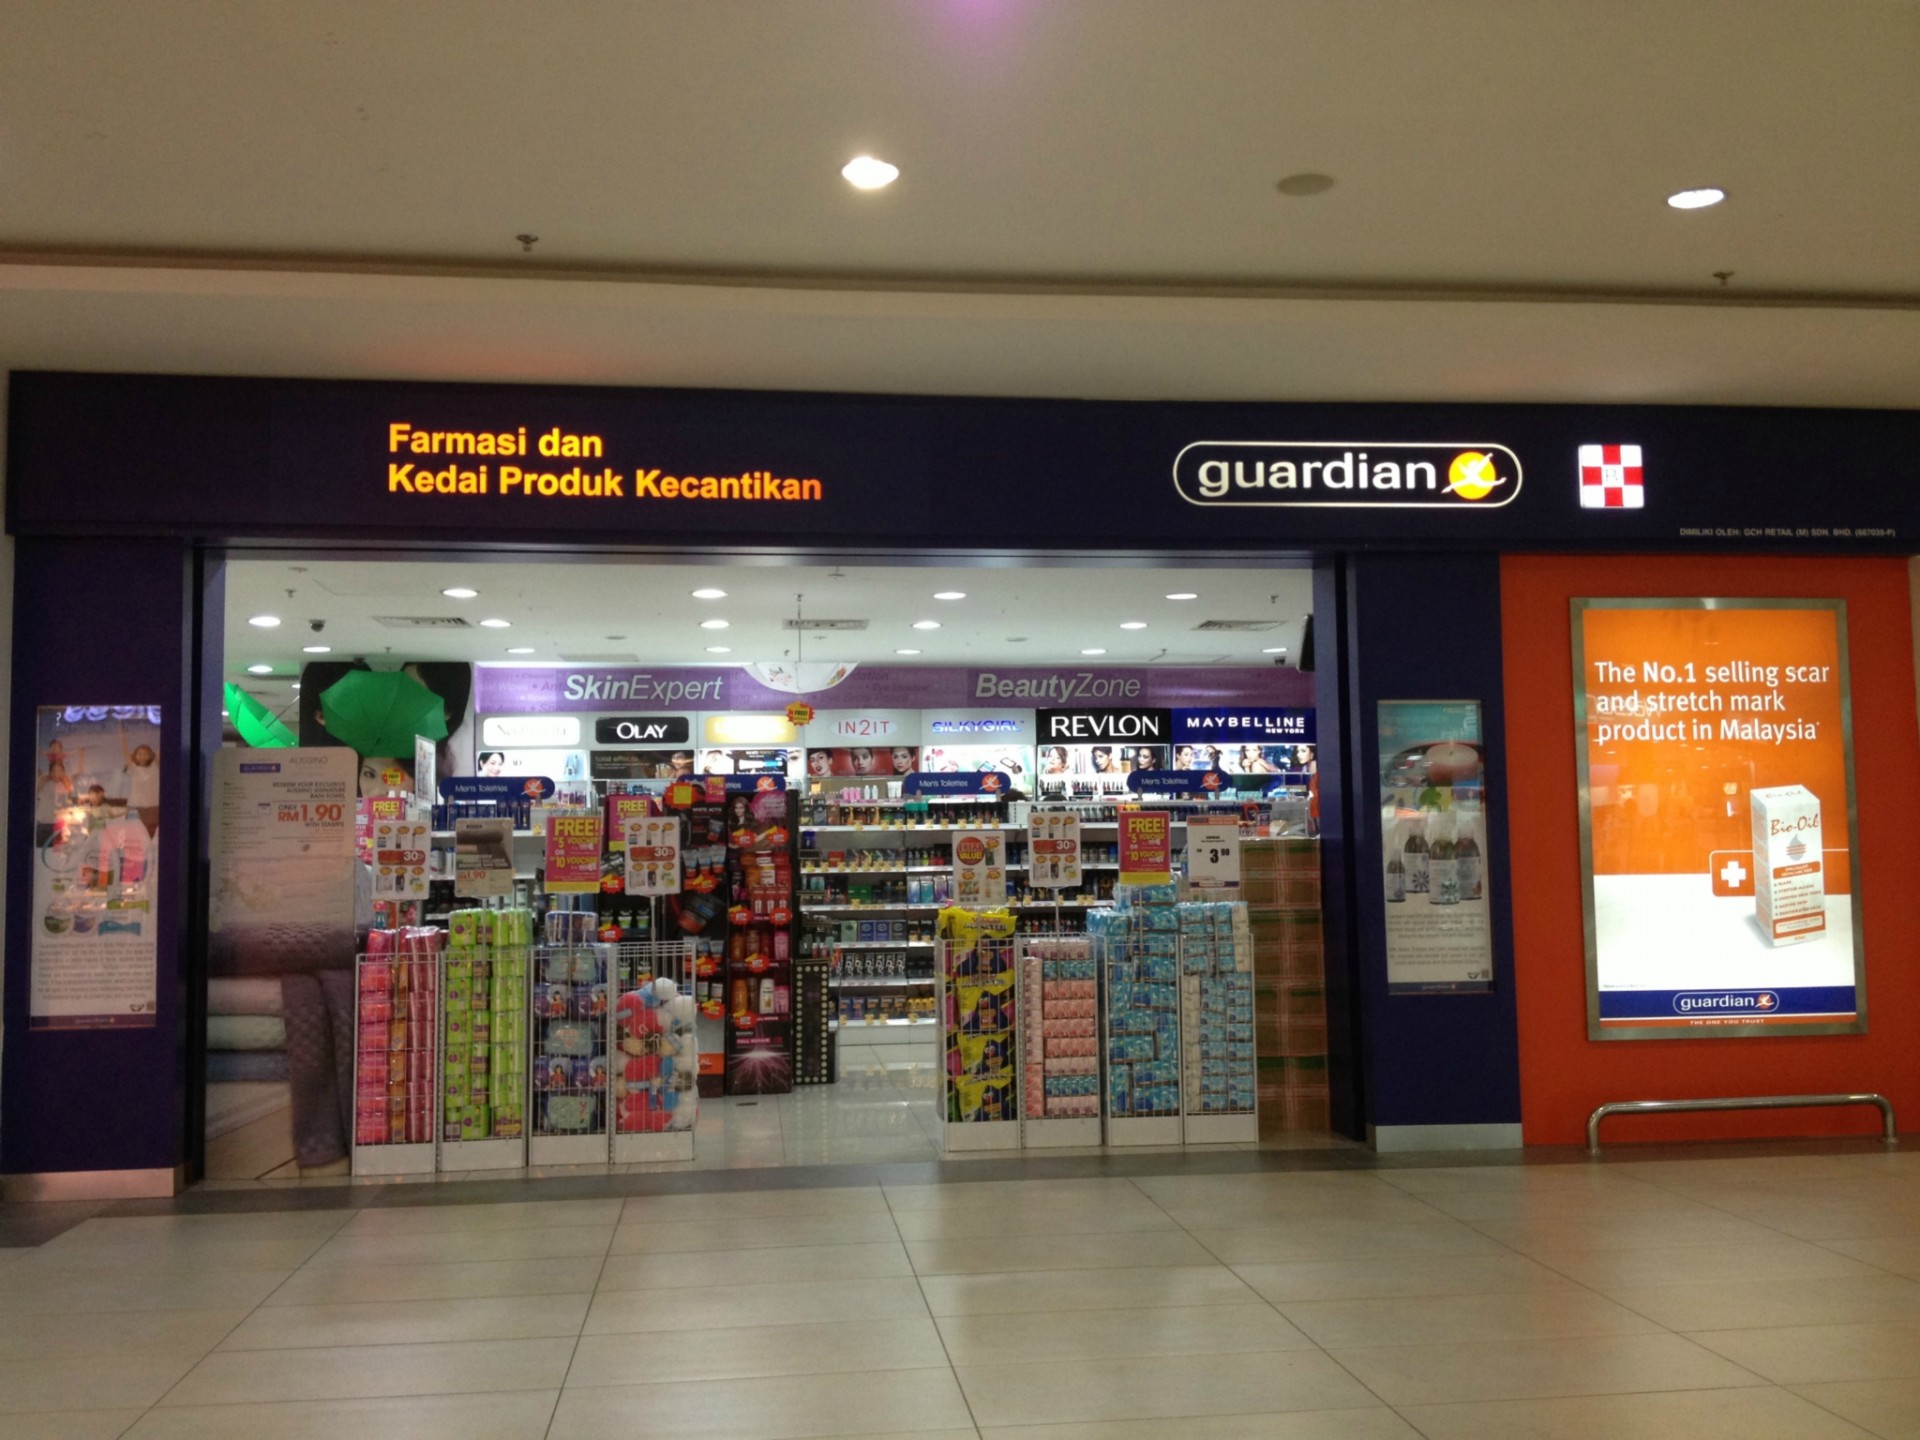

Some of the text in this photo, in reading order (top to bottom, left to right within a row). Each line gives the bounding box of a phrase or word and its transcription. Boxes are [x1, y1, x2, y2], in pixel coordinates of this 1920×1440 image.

[389, 423, 602, 457] Farmasi dan
[388, 463, 822, 500] Kedai Produk Kecantikan
[1198, 452, 1436, 497] guardian
[1764, 528, 1793, 536] RETAIL
[1594, 661, 1829, 687] The No.1 selling scar
[564, 674, 723, 706] SkinExpert
[975, 673, 1141, 702] BeautyZone
[1596, 690, 1638, 712] and
[1645, 690, 1723, 711] stretch
[1730, 690, 1786, 711] mark
[616, 722, 669, 739] OLAY
[838, 719, 889, 735] IN2IT
[932, 720, 1022, 733] SILKYGIRL
[1051, 715, 1159, 737] REVLON
[1187, 717, 1305, 728] MAYBELLINE
[1598, 719, 1686, 745] product
[1692, 719, 1712, 740] in
[373, 801, 399, 812] FREE!
[617, 800, 647, 811] FREE!
[278, 811, 299, 822] RM
[1128, 817, 1165, 833] FREE!
[1770, 813, 1819, 836] Bio-Oil
[555, 818, 599, 836] FREE!
[1210, 848, 1219, 863] 3
[1680, 994, 1754, 1011] guardian
